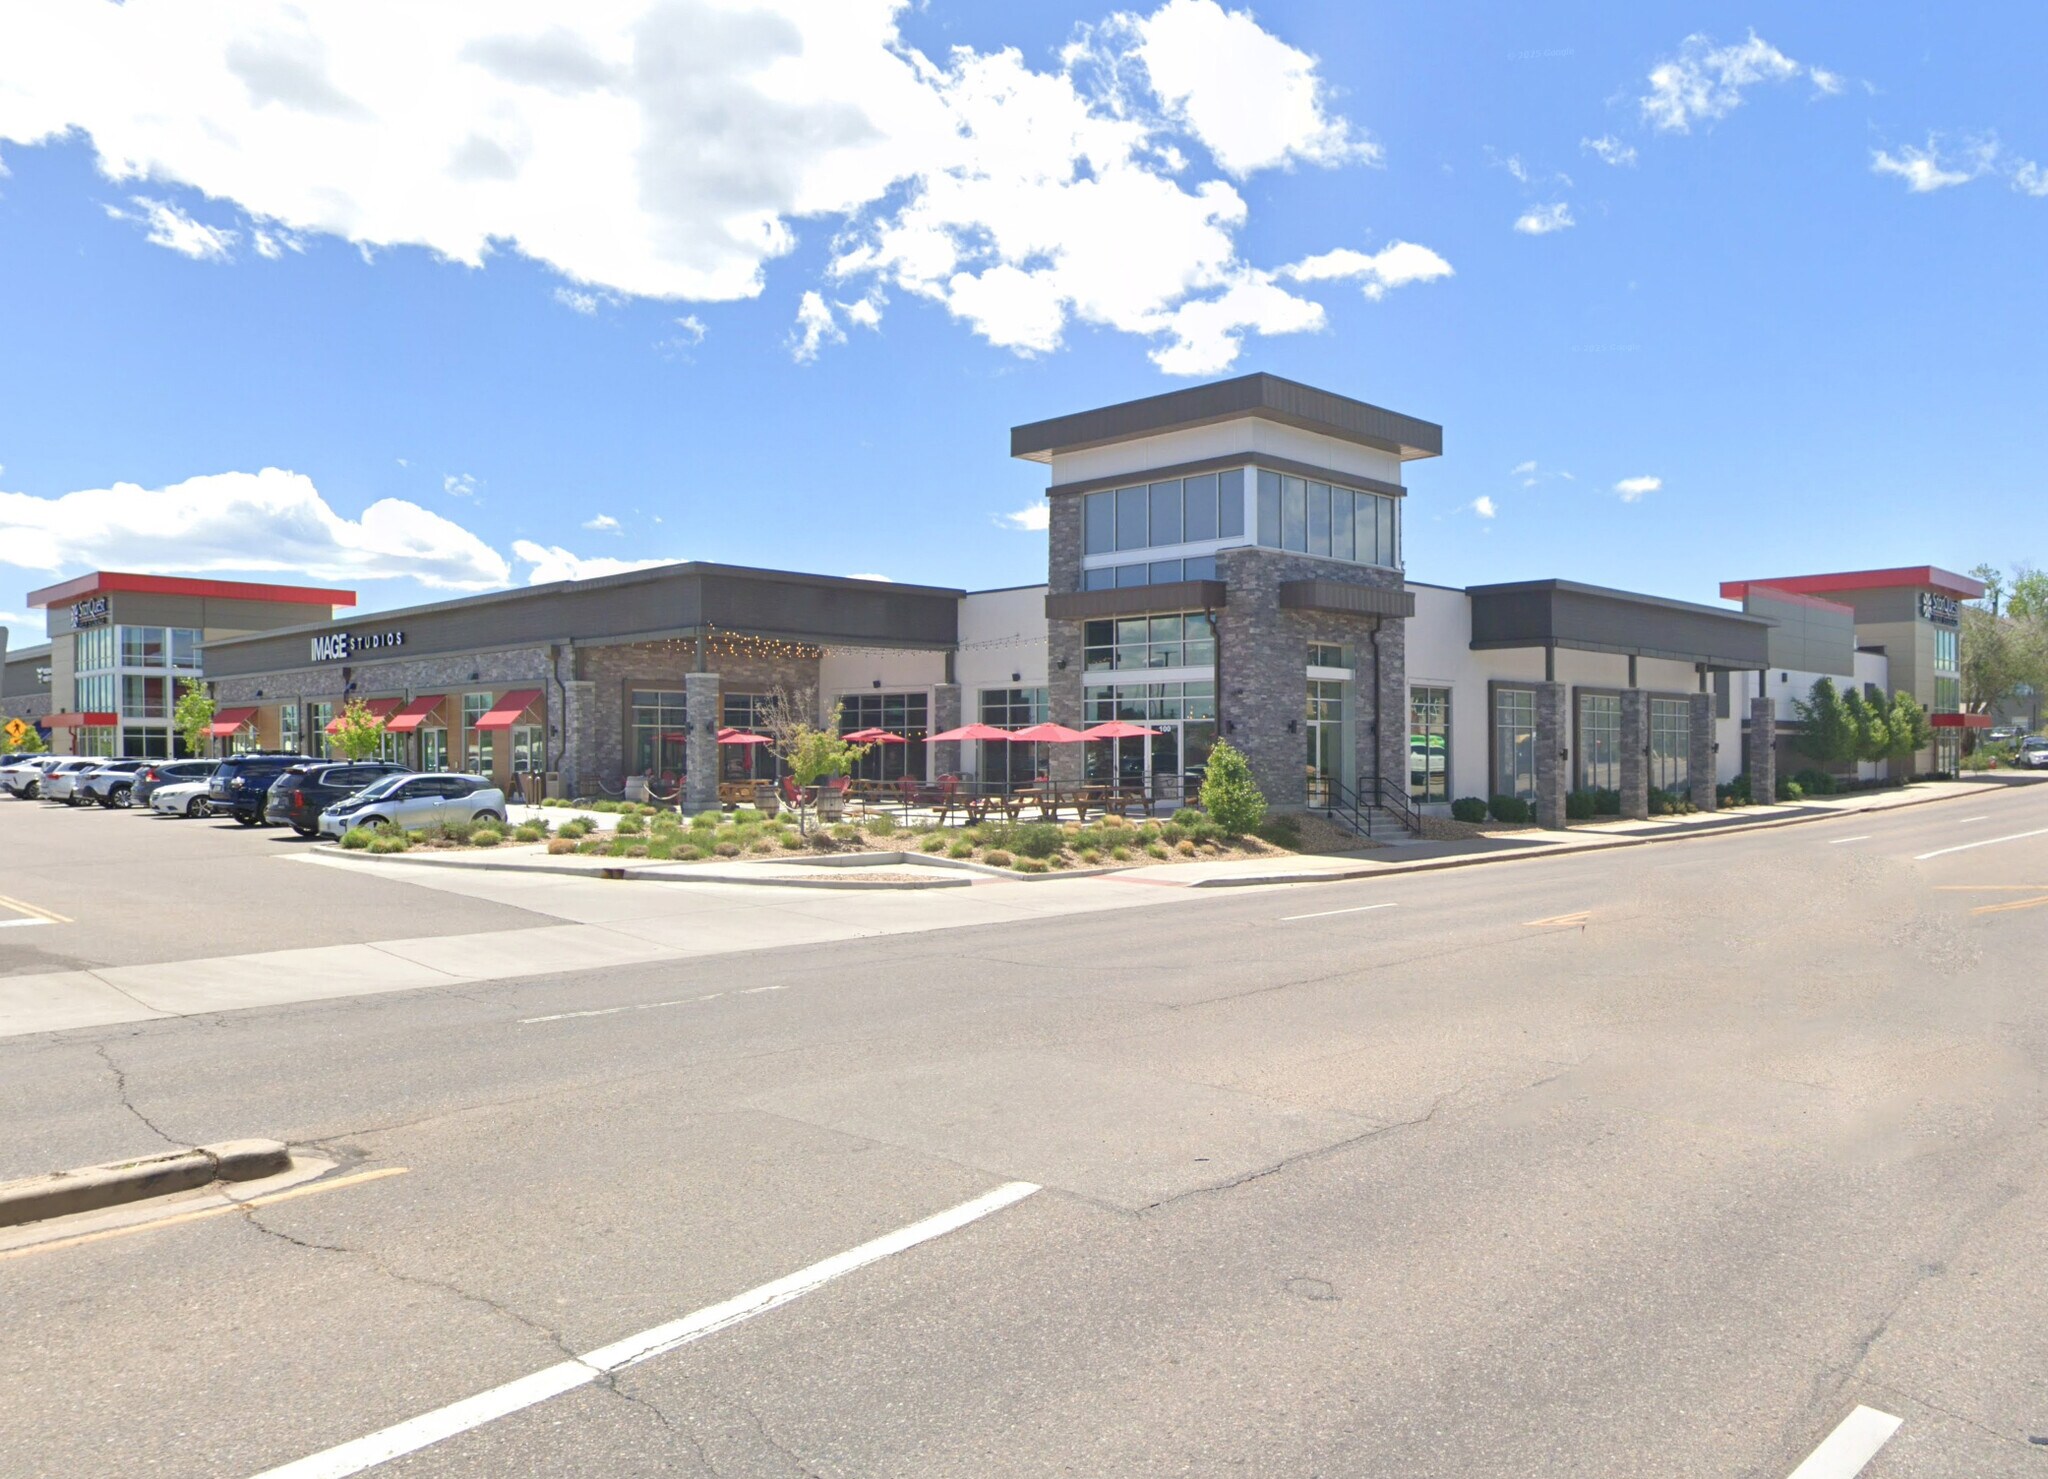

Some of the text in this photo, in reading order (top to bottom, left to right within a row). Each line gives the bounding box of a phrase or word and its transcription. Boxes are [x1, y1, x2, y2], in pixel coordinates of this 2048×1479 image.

[311, 632, 402, 661] IMAGE STUDIOS
[1159, 725, 1171, 733] 100
